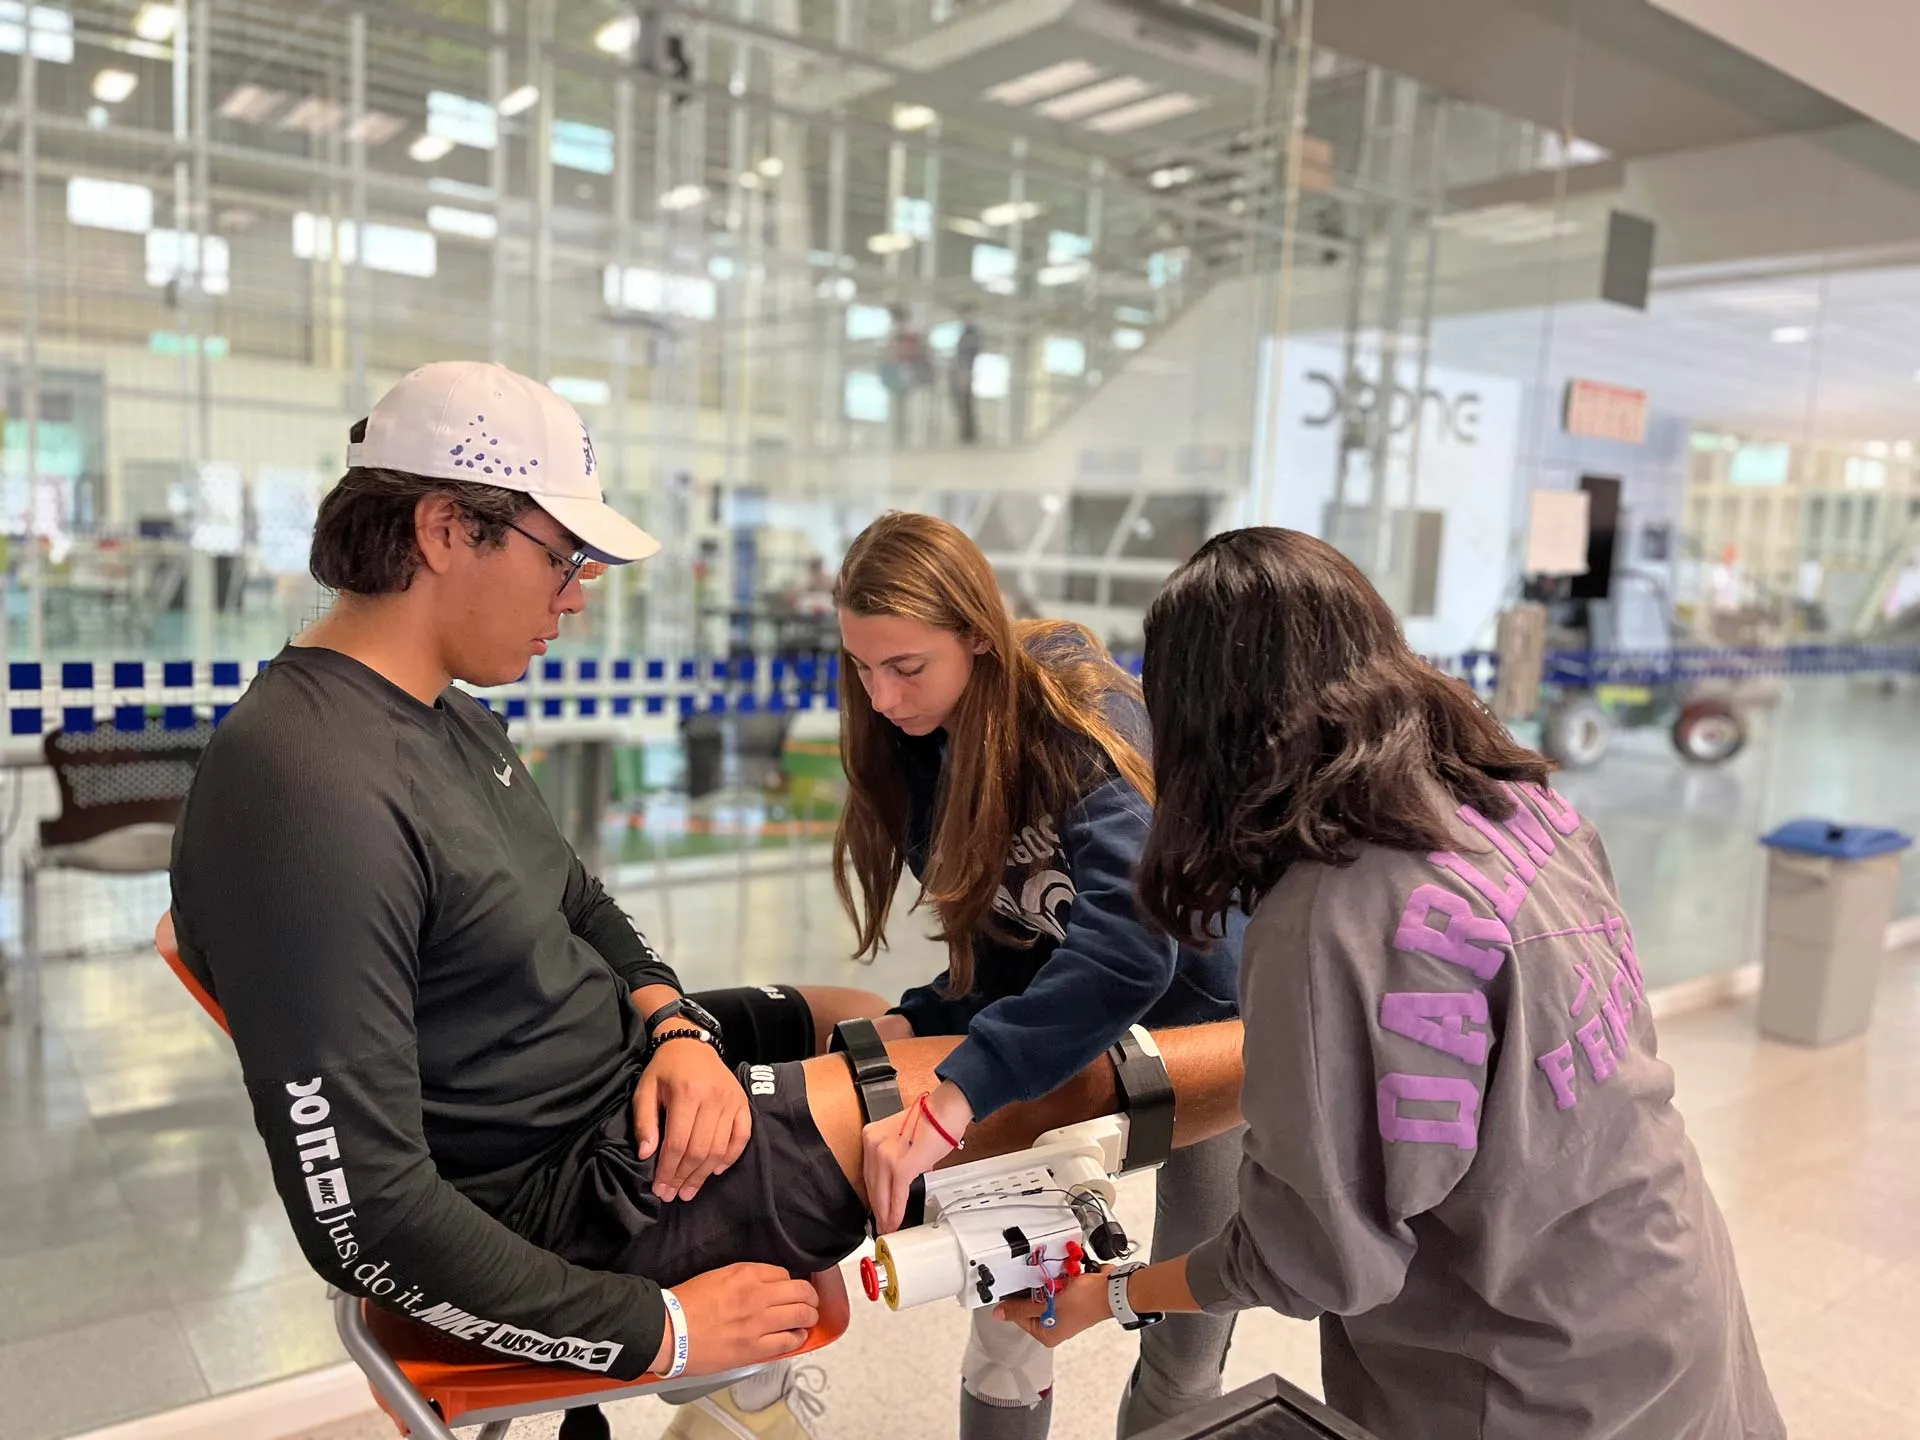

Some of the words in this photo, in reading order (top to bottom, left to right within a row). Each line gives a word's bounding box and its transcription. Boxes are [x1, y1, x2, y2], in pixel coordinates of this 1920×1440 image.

[317, 1177, 338, 1205] NIKE
[354, 1260, 396, 1296] do
[394, 1285, 424, 1312] it.
[410, 1302, 500, 1341] NIKE
[678, 1335, 687, 1359] ROW
